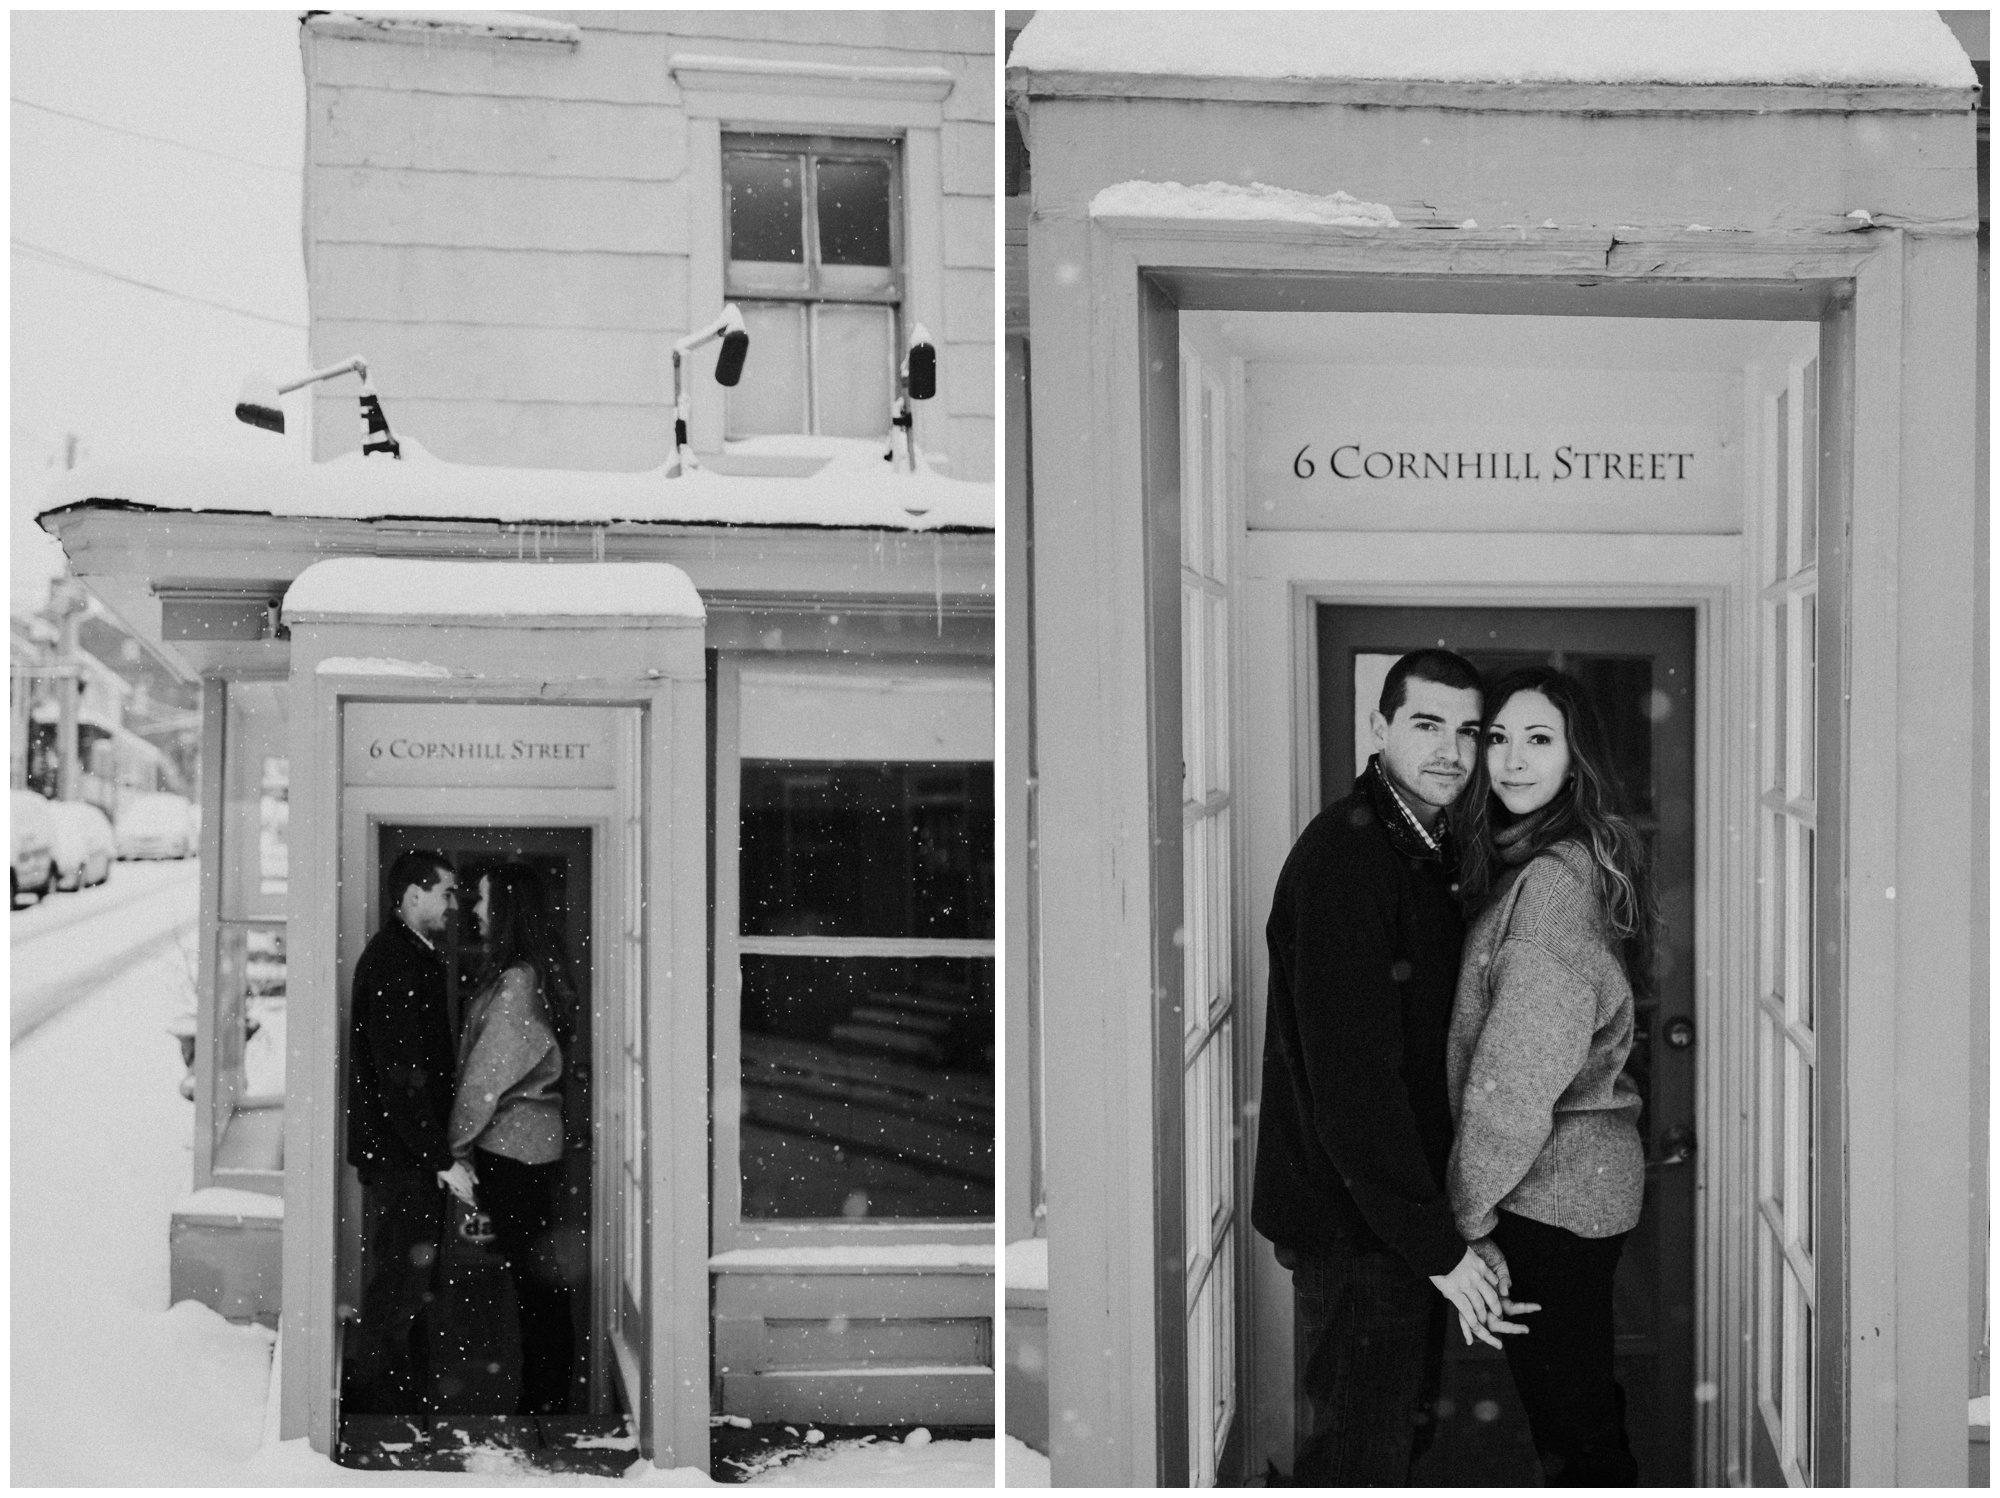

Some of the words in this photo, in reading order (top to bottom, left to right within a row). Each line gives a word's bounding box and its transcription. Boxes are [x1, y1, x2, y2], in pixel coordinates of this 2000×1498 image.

[1293, 444, 1315, 480] 6
[1330, 444, 1540, 481] CORNHILL
[1553, 444, 1695, 481] STREET
[369, 739, 382, 759] 6
[511, 739, 590, 760] STREET
